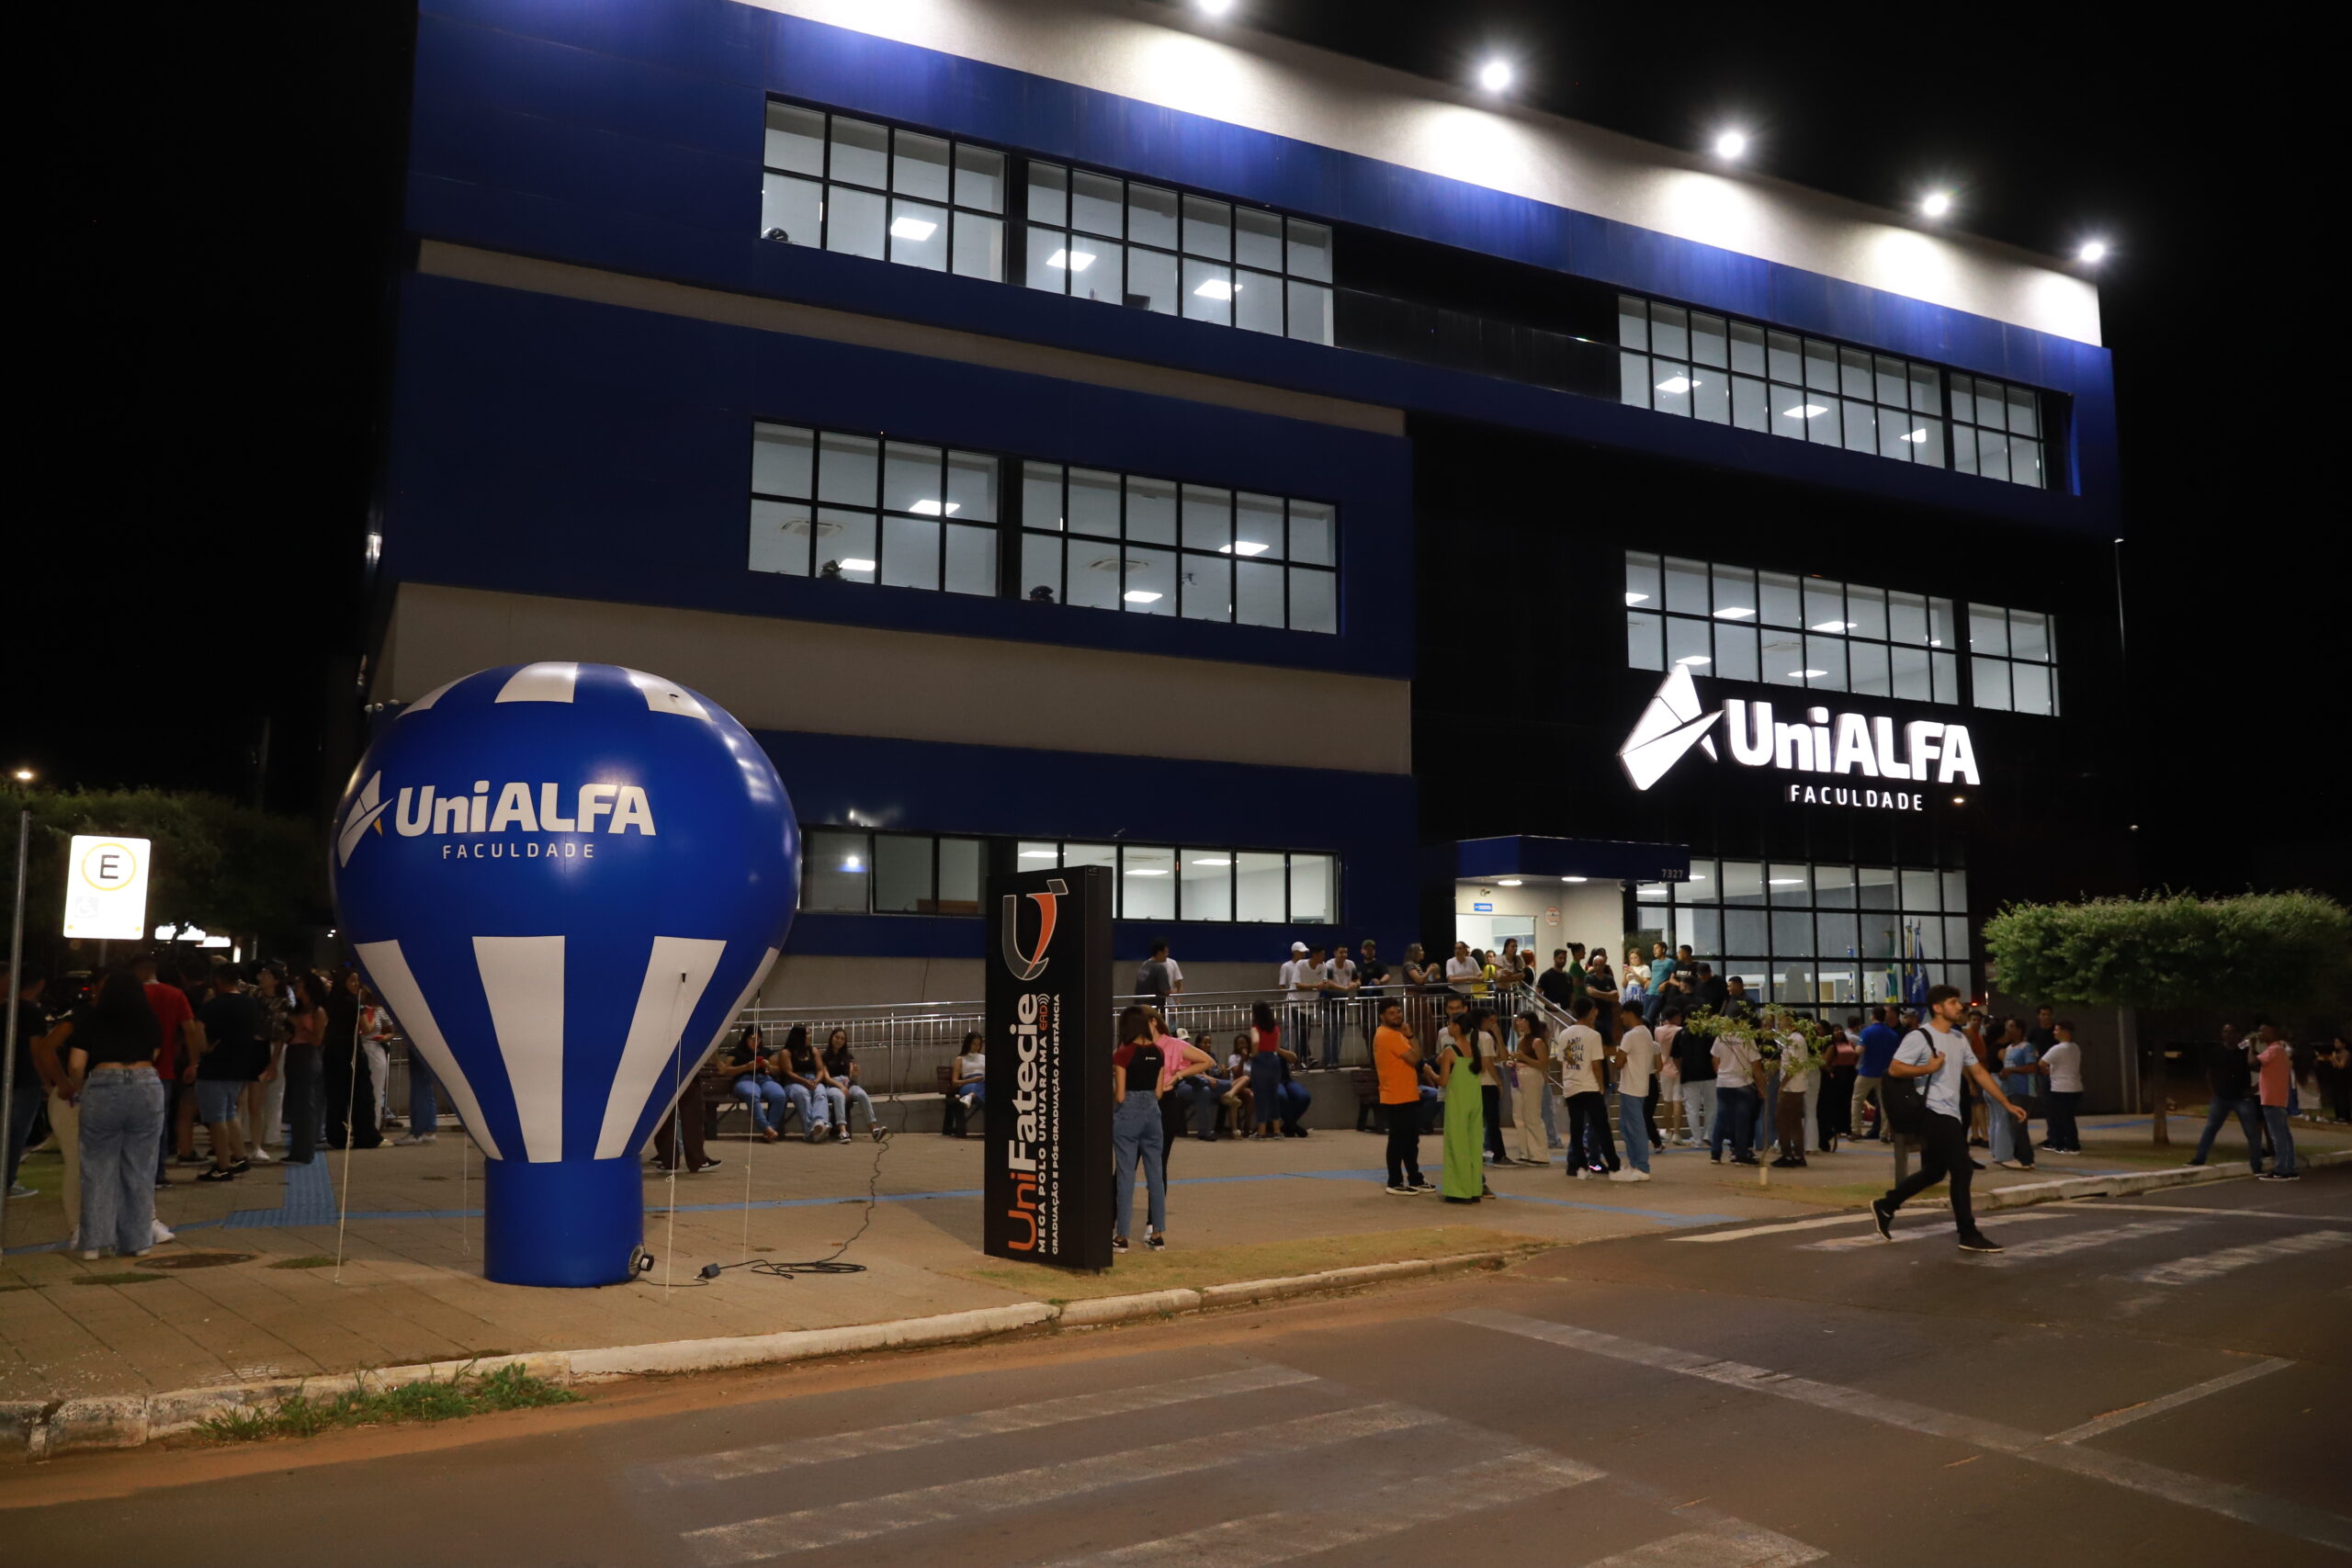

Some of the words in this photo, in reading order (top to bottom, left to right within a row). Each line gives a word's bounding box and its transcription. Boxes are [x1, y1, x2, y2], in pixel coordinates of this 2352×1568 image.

[1723, 698, 1981, 785] UniALFA
[395, 780, 657, 837] UniALFA
[1790, 784, 1923, 812] FACULDADE
[99, 854, 119, 879] E
[442, 842, 594, 860] FACULDADE
[1661, 868, 1683, 879] 7327
[1039, 1005, 1048, 1031] EAD
[1052, 994, 1060, 1055] DISTÂNCIA
[1038, 1035, 1047, 1141] UMUARAMA
[1008, 993, 1038, 1251] UniFatecie
[1051, 1068, 1060, 1168] PÓS-GRADUAÇÃO
[1038, 1147, 1046, 1196] POLO
[1038, 1201, 1046, 1253] MEGA
[1051, 1181, 1059, 1255] GRADUAÇÃO
